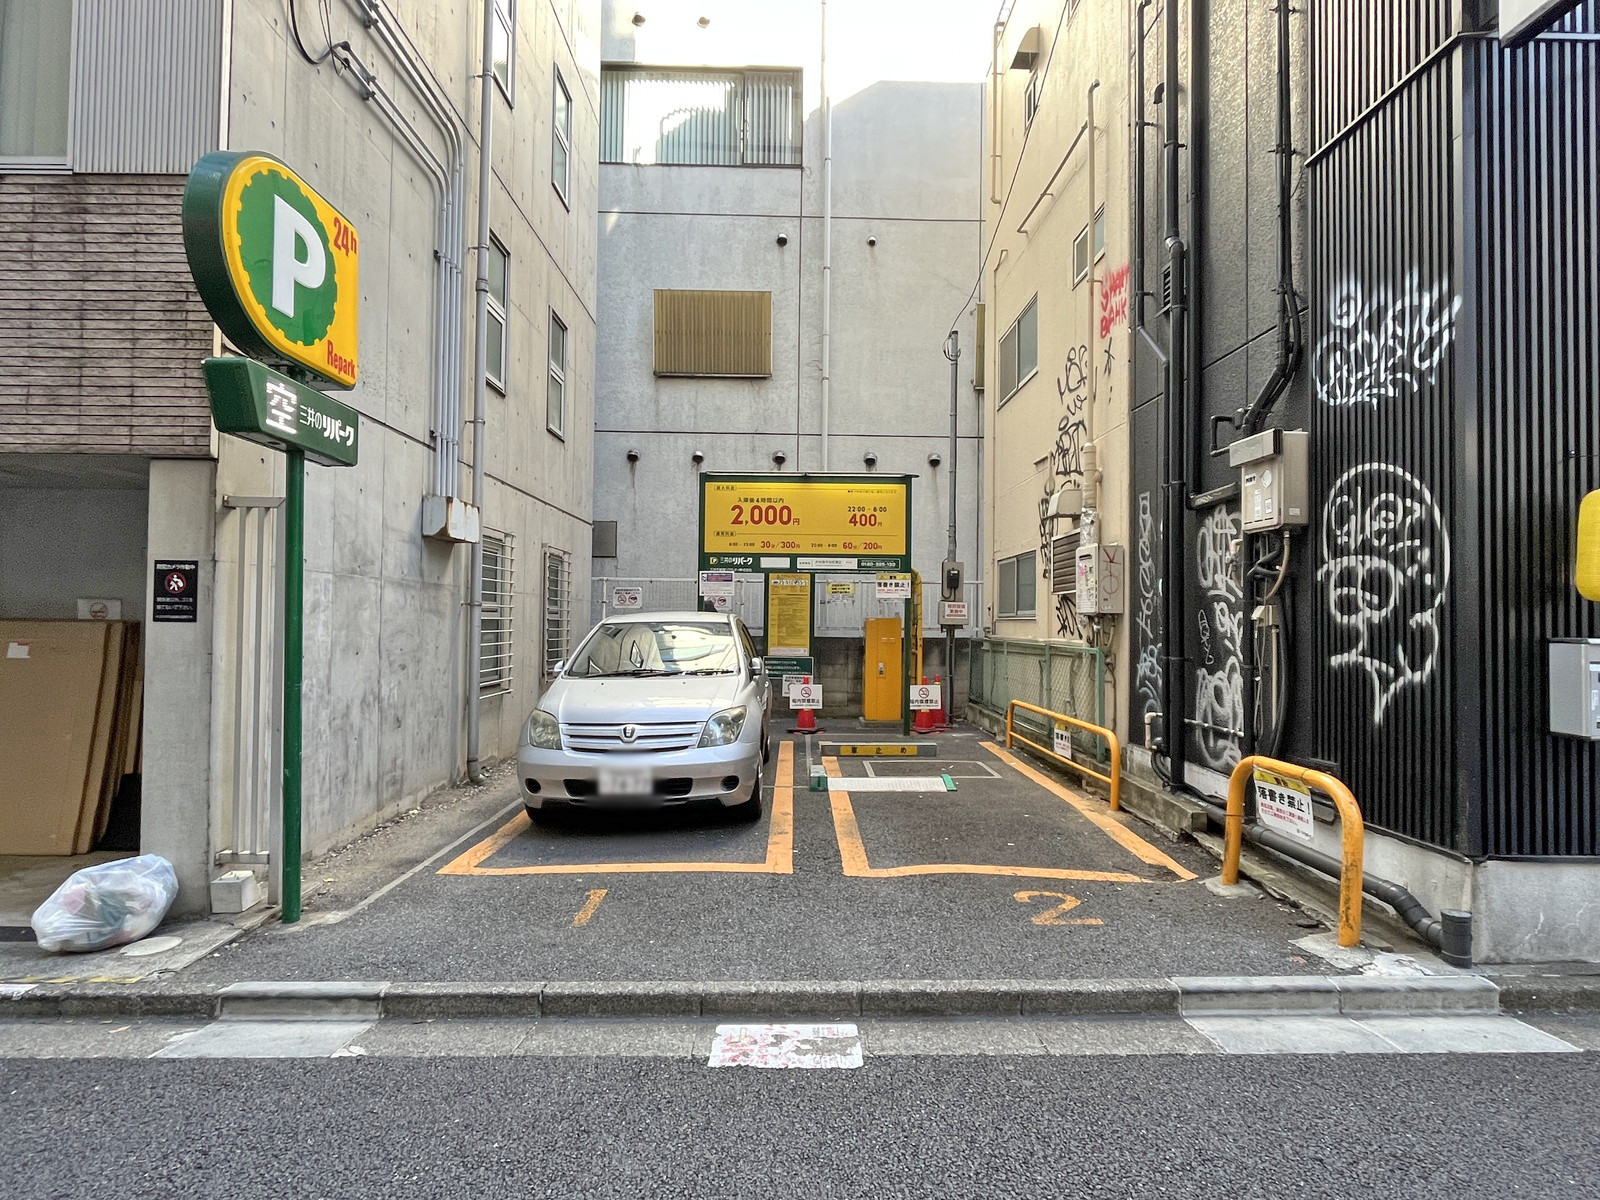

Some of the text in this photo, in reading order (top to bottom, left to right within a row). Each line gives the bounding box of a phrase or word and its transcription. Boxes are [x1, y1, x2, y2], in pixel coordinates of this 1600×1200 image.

[272, 193, 326, 318] P
[333, 216, 357, 257] 24h
[326, 339, 356, 380] Repark
[265, 382, 297, 435] 空
[299, 404, 354, 447] 三井のリパーク
[731, 504, 800, 526] 2,000円
[1012, 890, 1106, 927] 2
